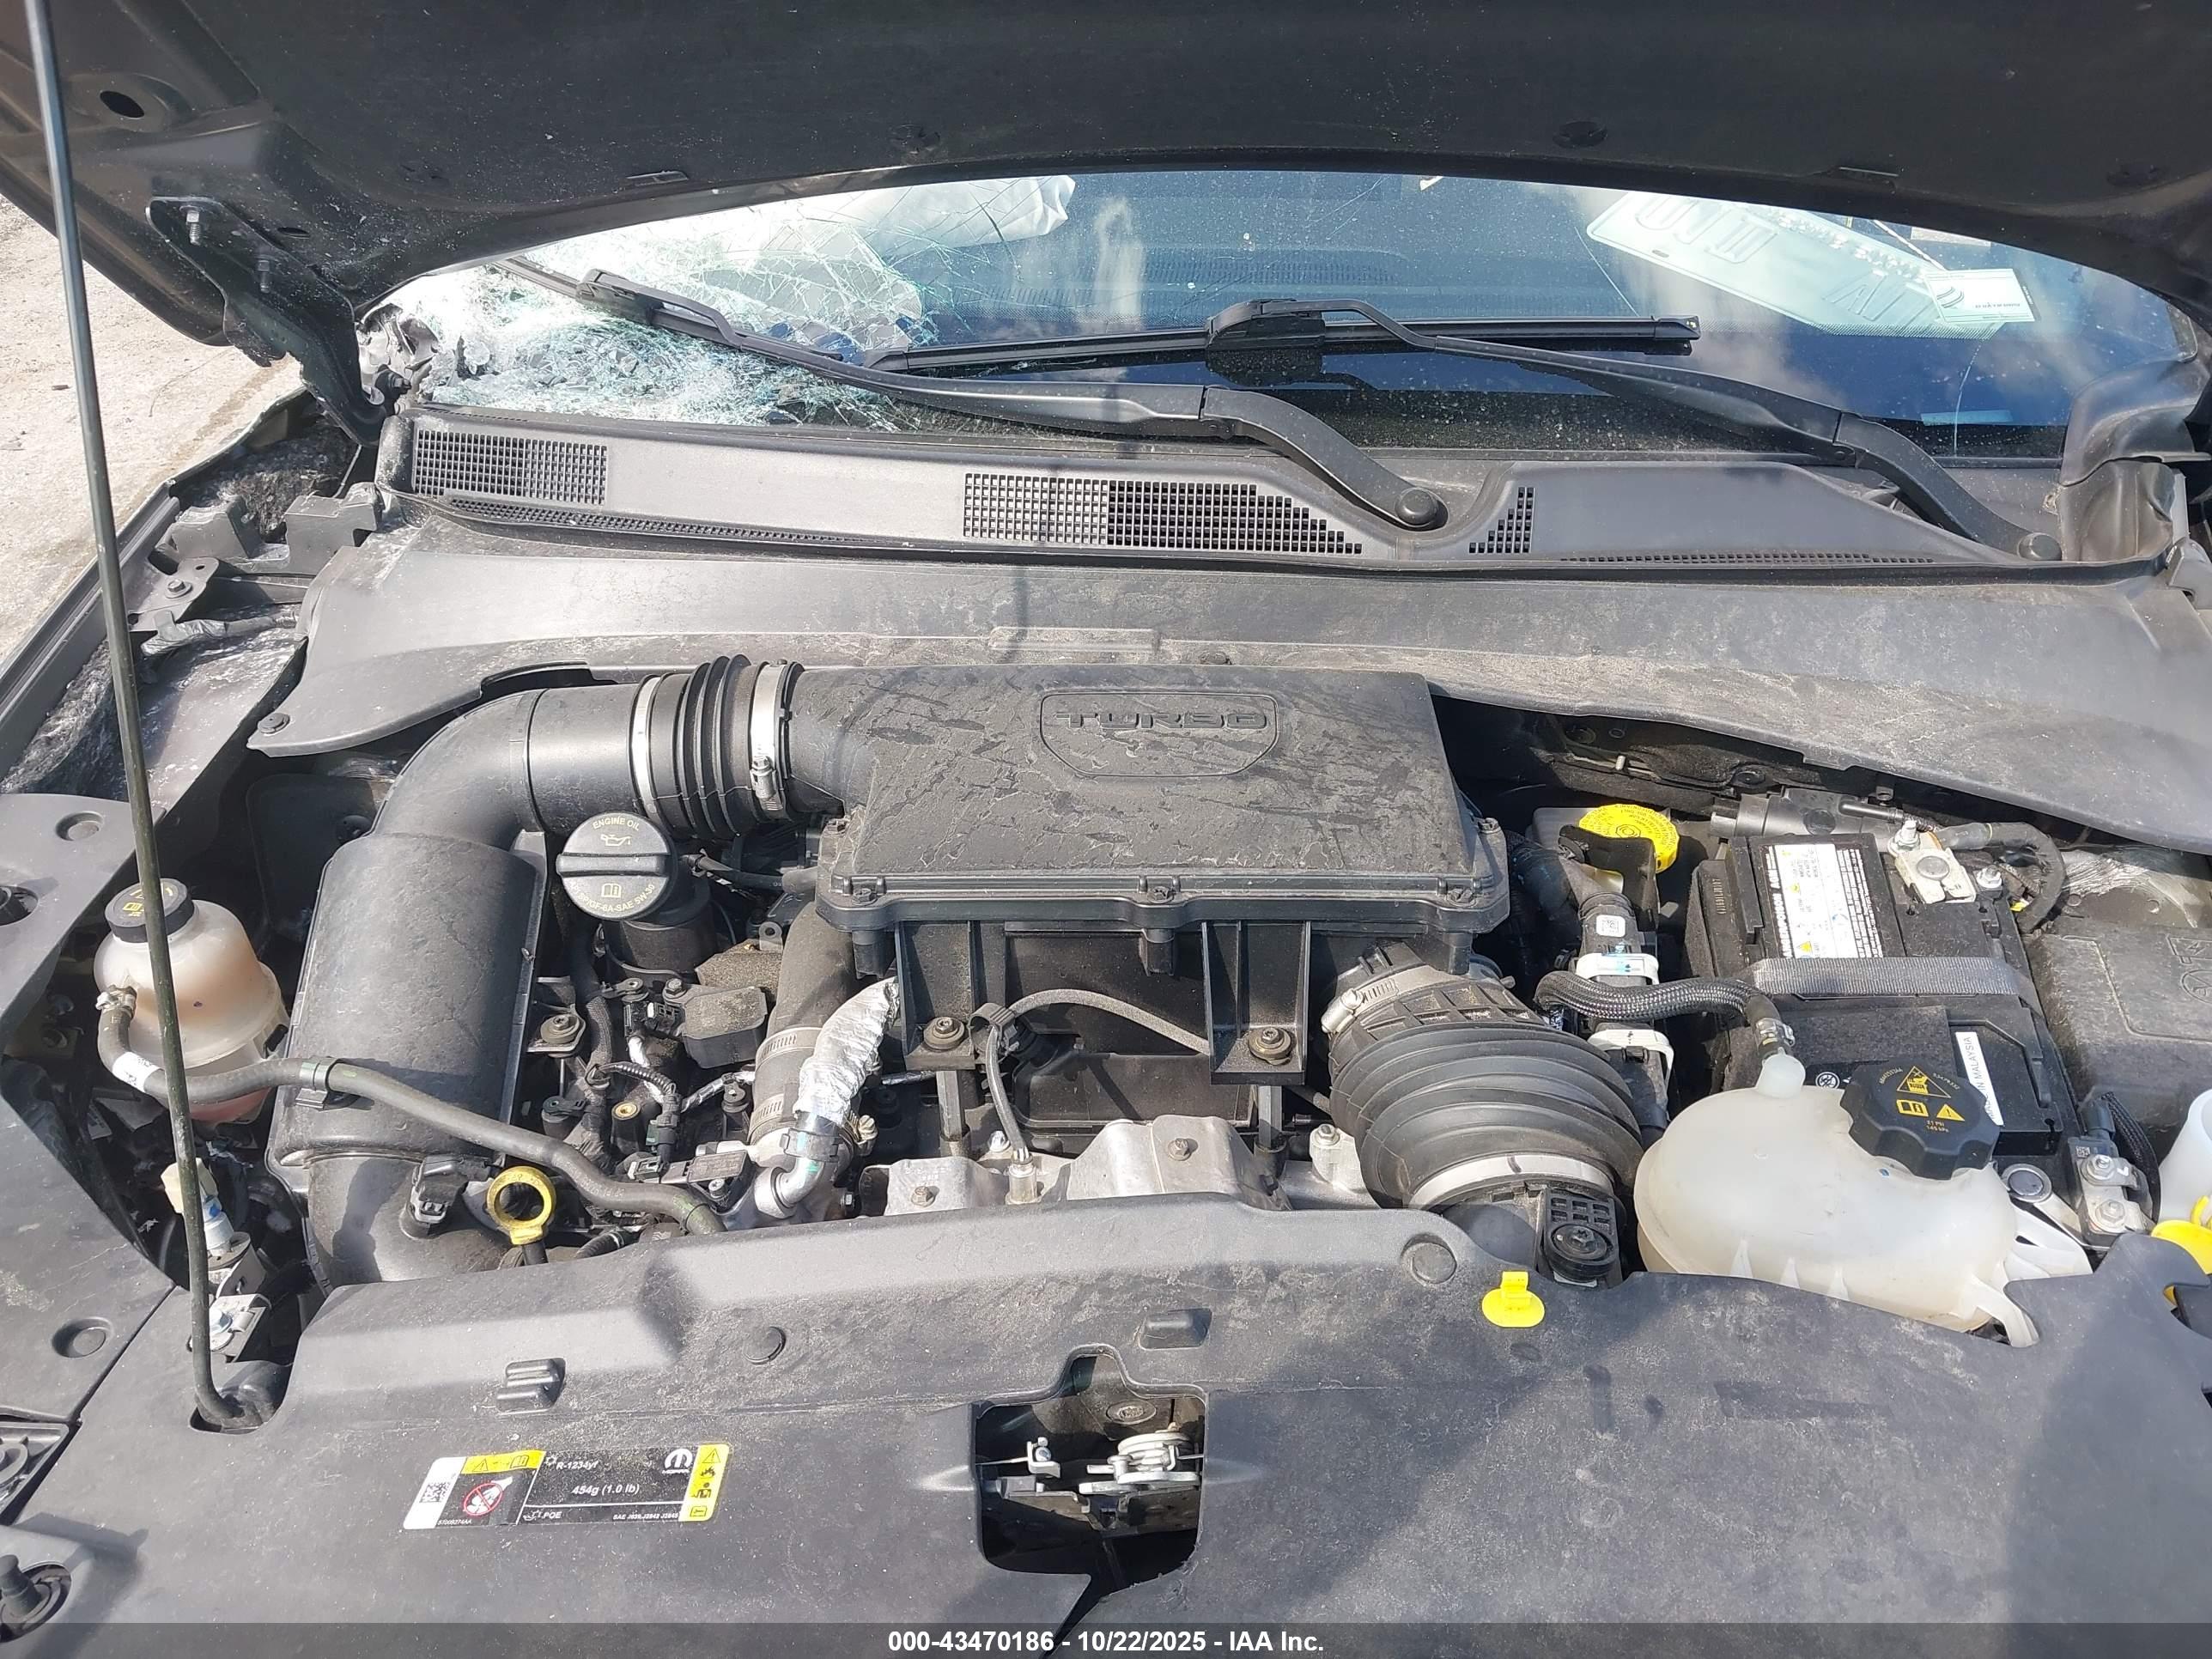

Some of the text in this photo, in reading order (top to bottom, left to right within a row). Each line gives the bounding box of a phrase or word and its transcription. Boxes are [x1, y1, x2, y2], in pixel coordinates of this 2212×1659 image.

[1055, 712, 1267, 730] TURBO
[592, 817, 641, 831] ENGINE OIL
[635, 884, 655, 904] 5W-30
[1964, 1036, 1983, 1080] MALAYSIA
[1977, 1082, 1985, 1091] IN
[556, 1461, 599, 1471] R-1234yf
[572, 1484, 640, 1496] 454g (1.0 lb)
